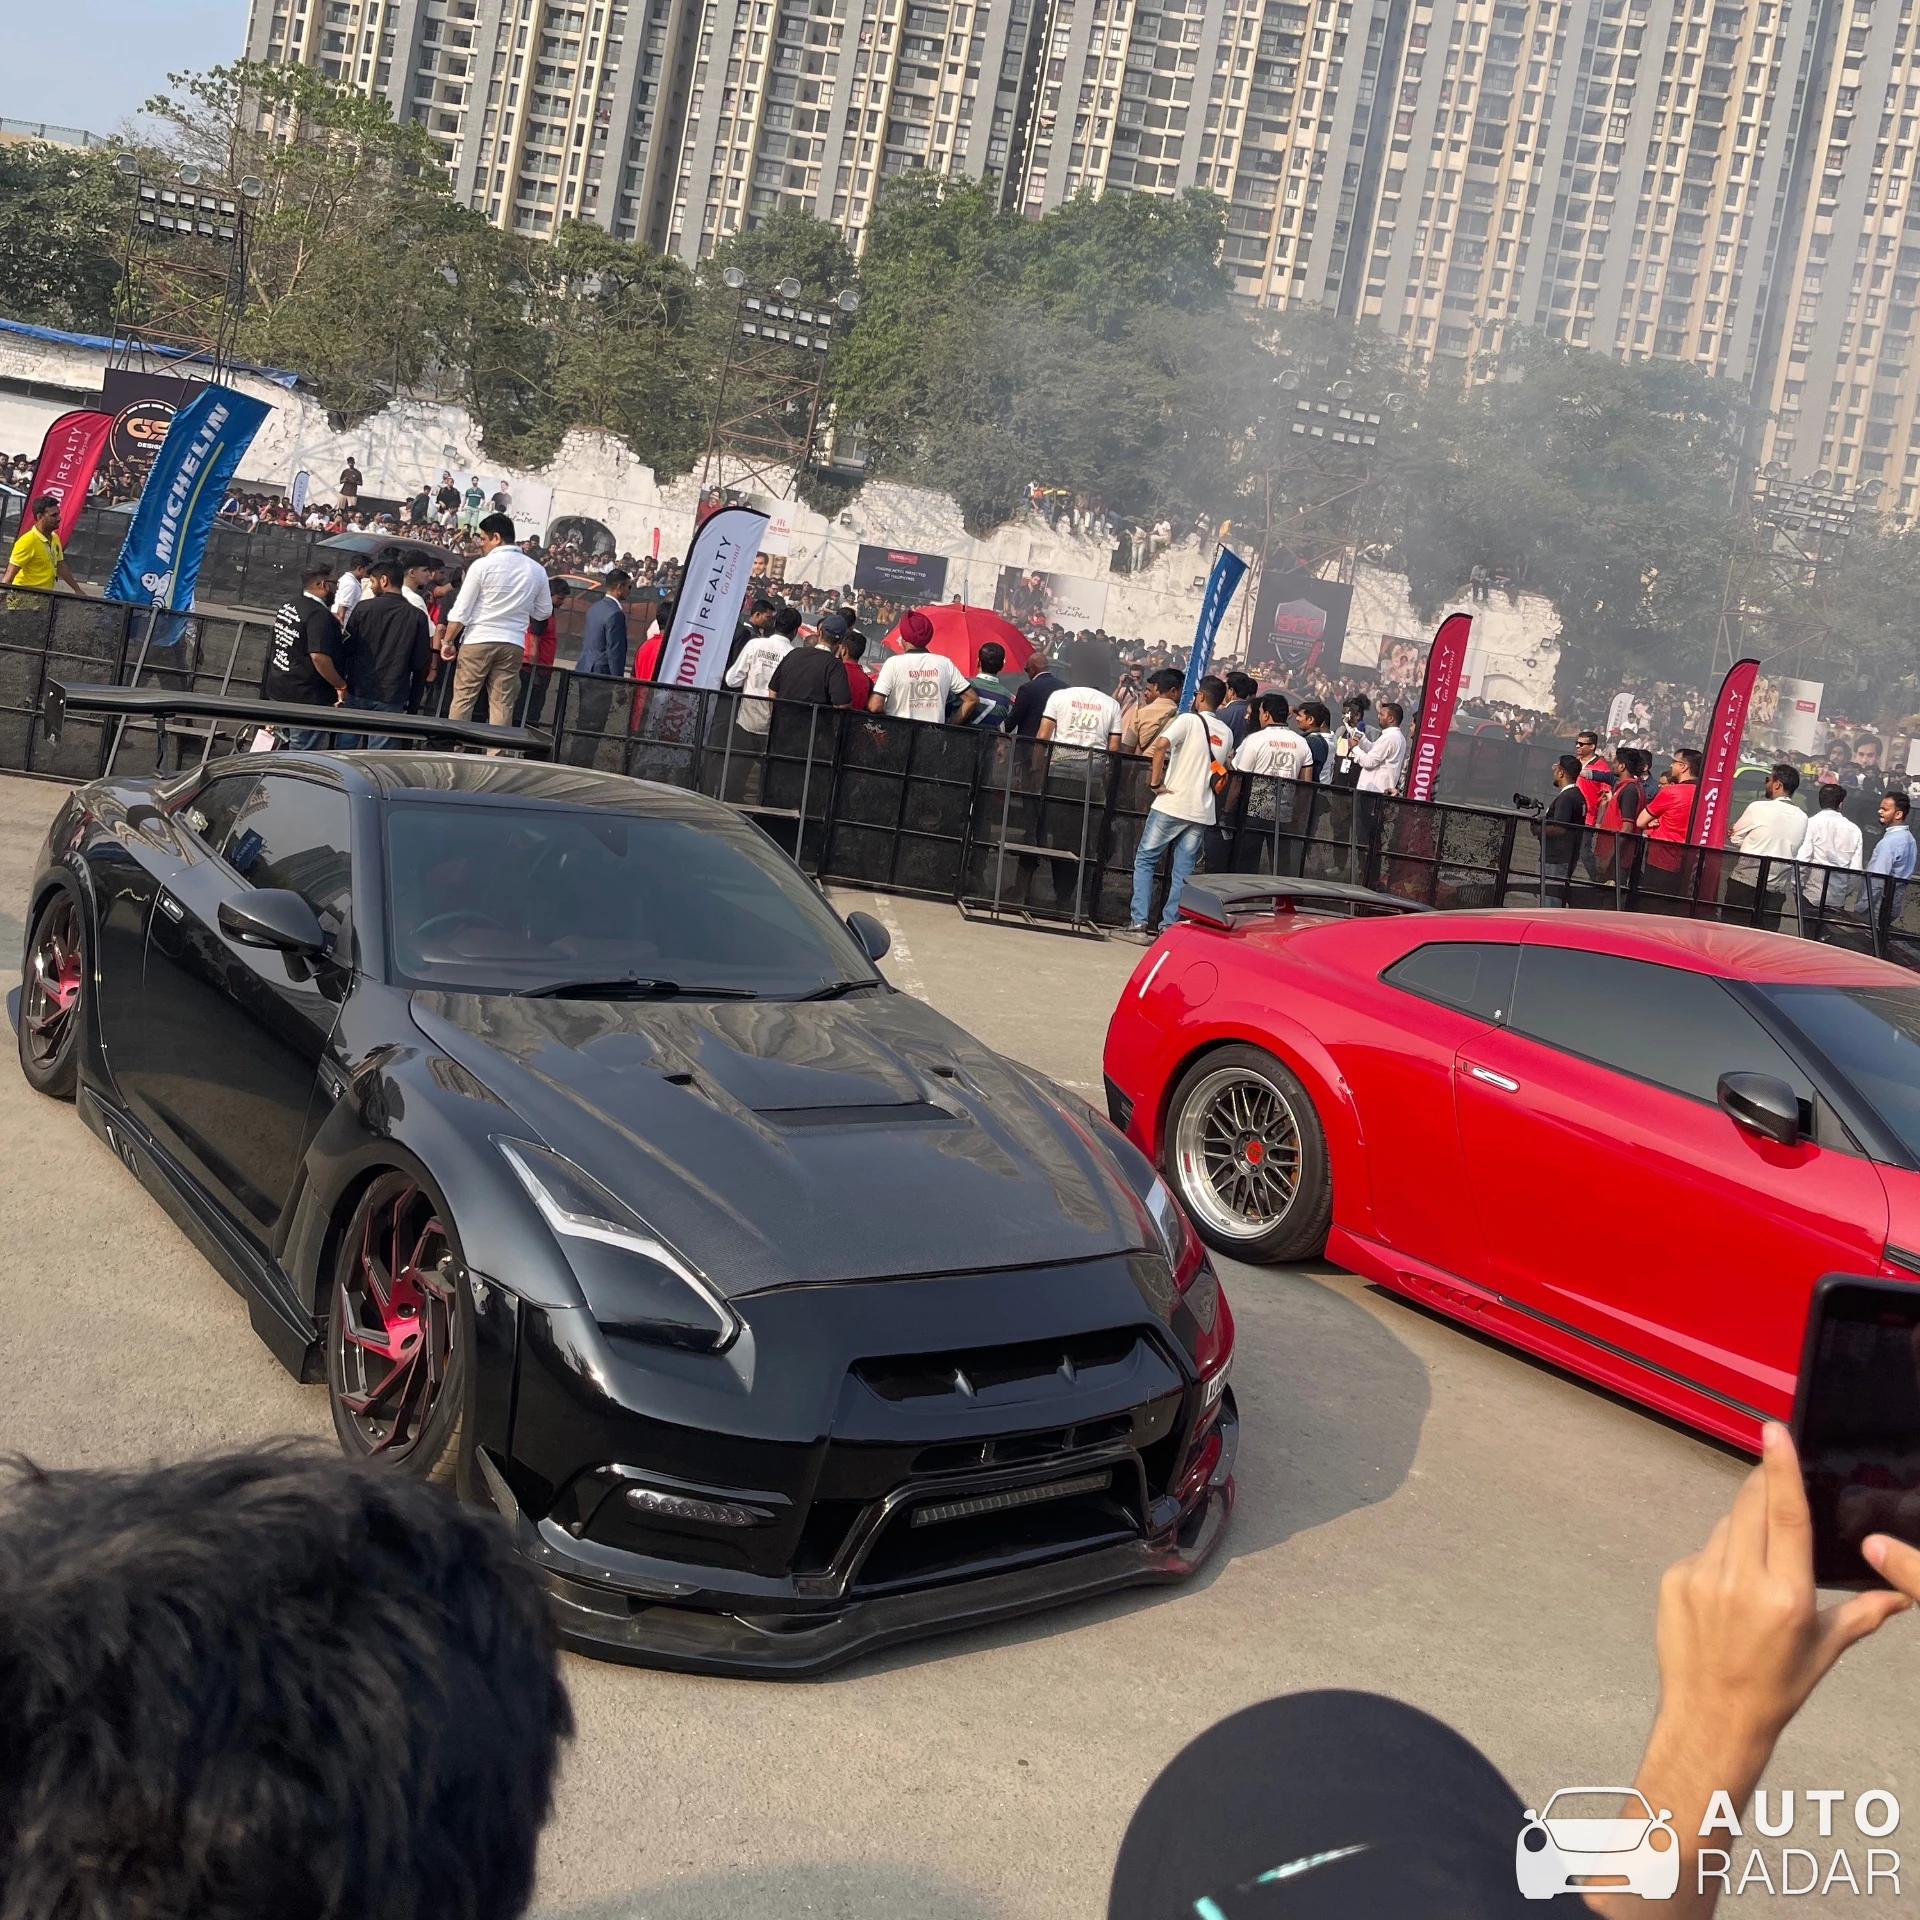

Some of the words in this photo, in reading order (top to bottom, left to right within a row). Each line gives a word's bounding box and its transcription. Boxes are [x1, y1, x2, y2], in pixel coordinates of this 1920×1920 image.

[57, 427, 82, 480] REALTY
[77, 432, 91, 456] Beyond
[155, 402, 230, 565] MICHELIN
[700, 536, 732, 619] REALTY
[720, 582, 729, 595] Go
[725, 543, 742, 583] Beyond
[1195, 568, 1227, 691] ICHELIN
[1277, 613, 1322, 637] SCC
[909, 680, 939, 700] 100
[1427, 645, 1450, 729] REALTY
[1717, 689, 1739, 773] REALTY
